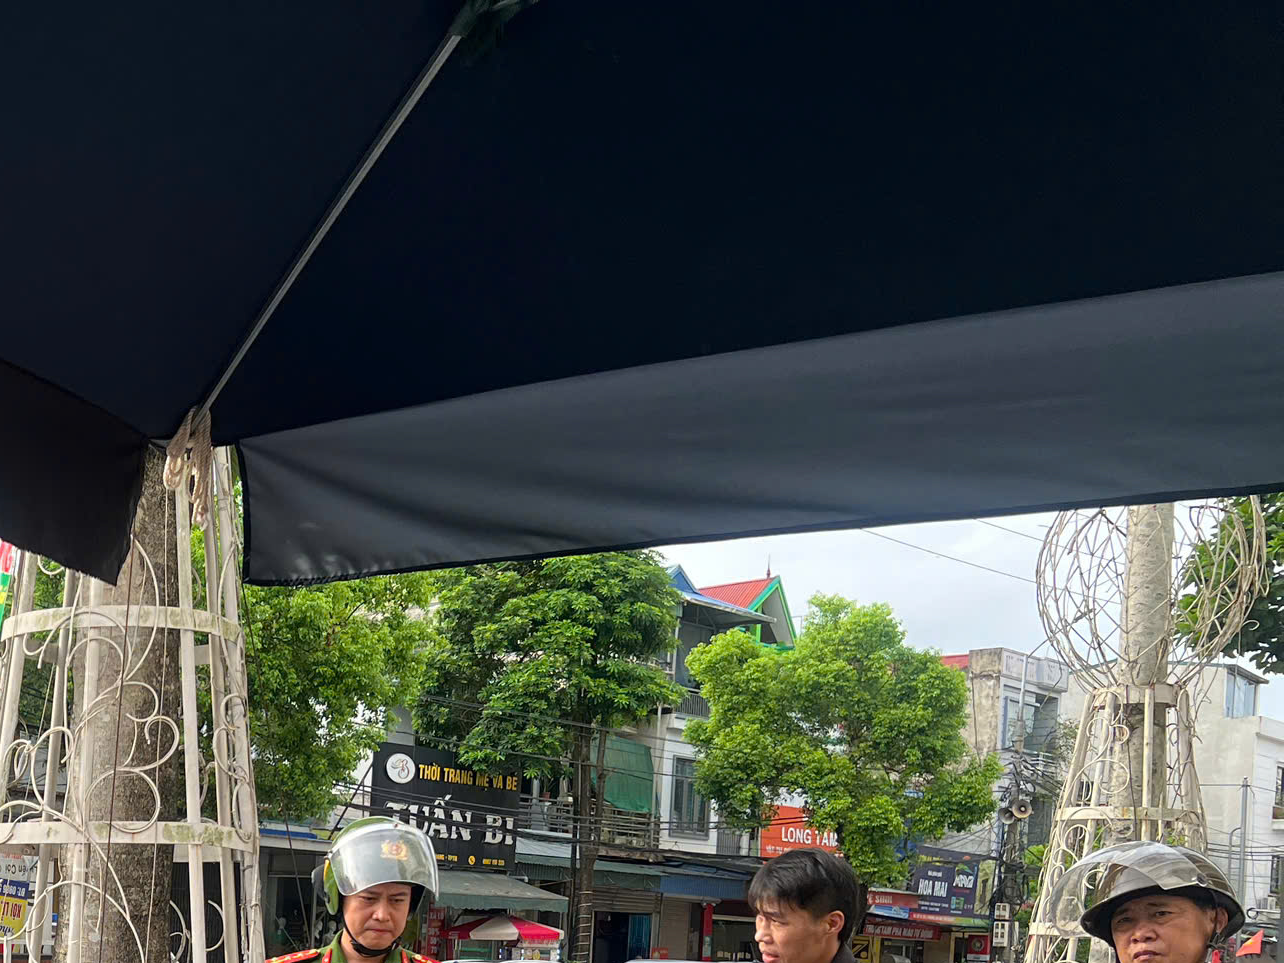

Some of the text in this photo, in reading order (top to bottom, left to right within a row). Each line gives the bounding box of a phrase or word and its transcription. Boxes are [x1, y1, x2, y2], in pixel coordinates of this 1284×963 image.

[418, 761, 441, 782] THỜI
[444, 767, 473, 785] TRANG
[781, 826, 812, 845] LONG
